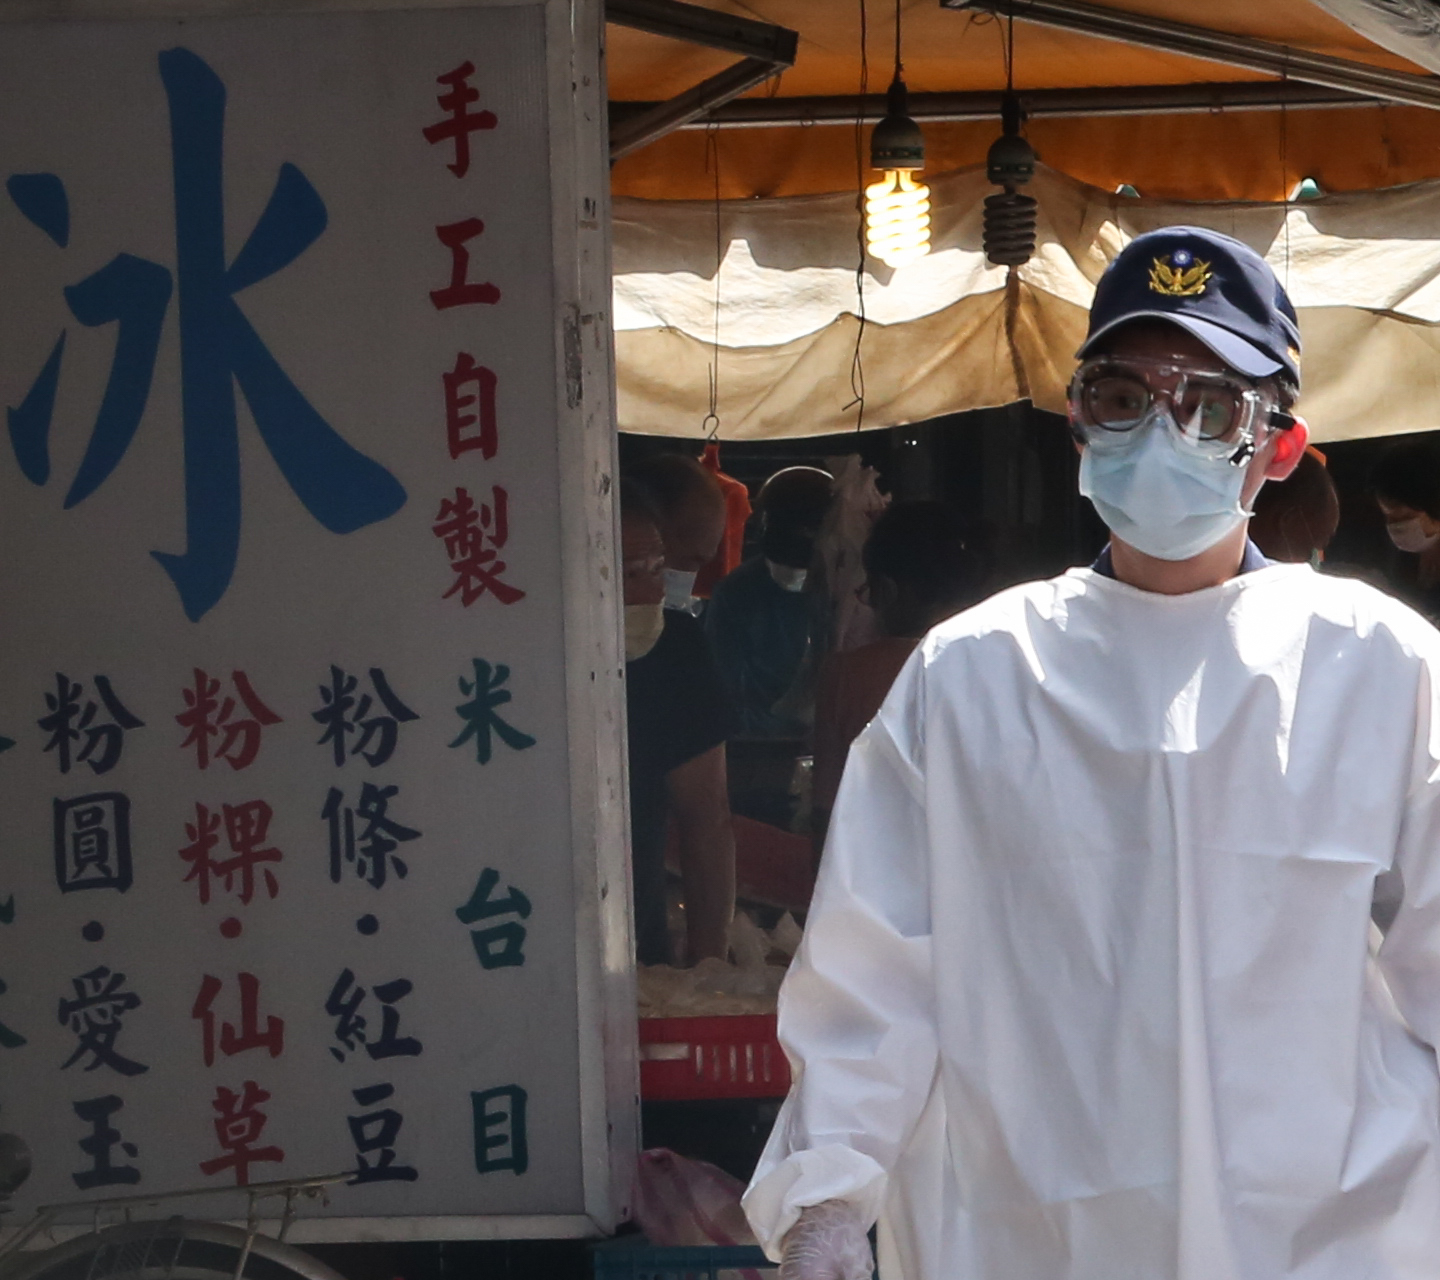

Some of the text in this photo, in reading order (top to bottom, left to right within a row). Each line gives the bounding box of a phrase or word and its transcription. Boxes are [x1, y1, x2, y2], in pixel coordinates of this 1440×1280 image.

[4, 45, 408, 623] 冰
[421, 60, 527, 610] 手工自製
[447, 655, 537, 1179] 米台目
